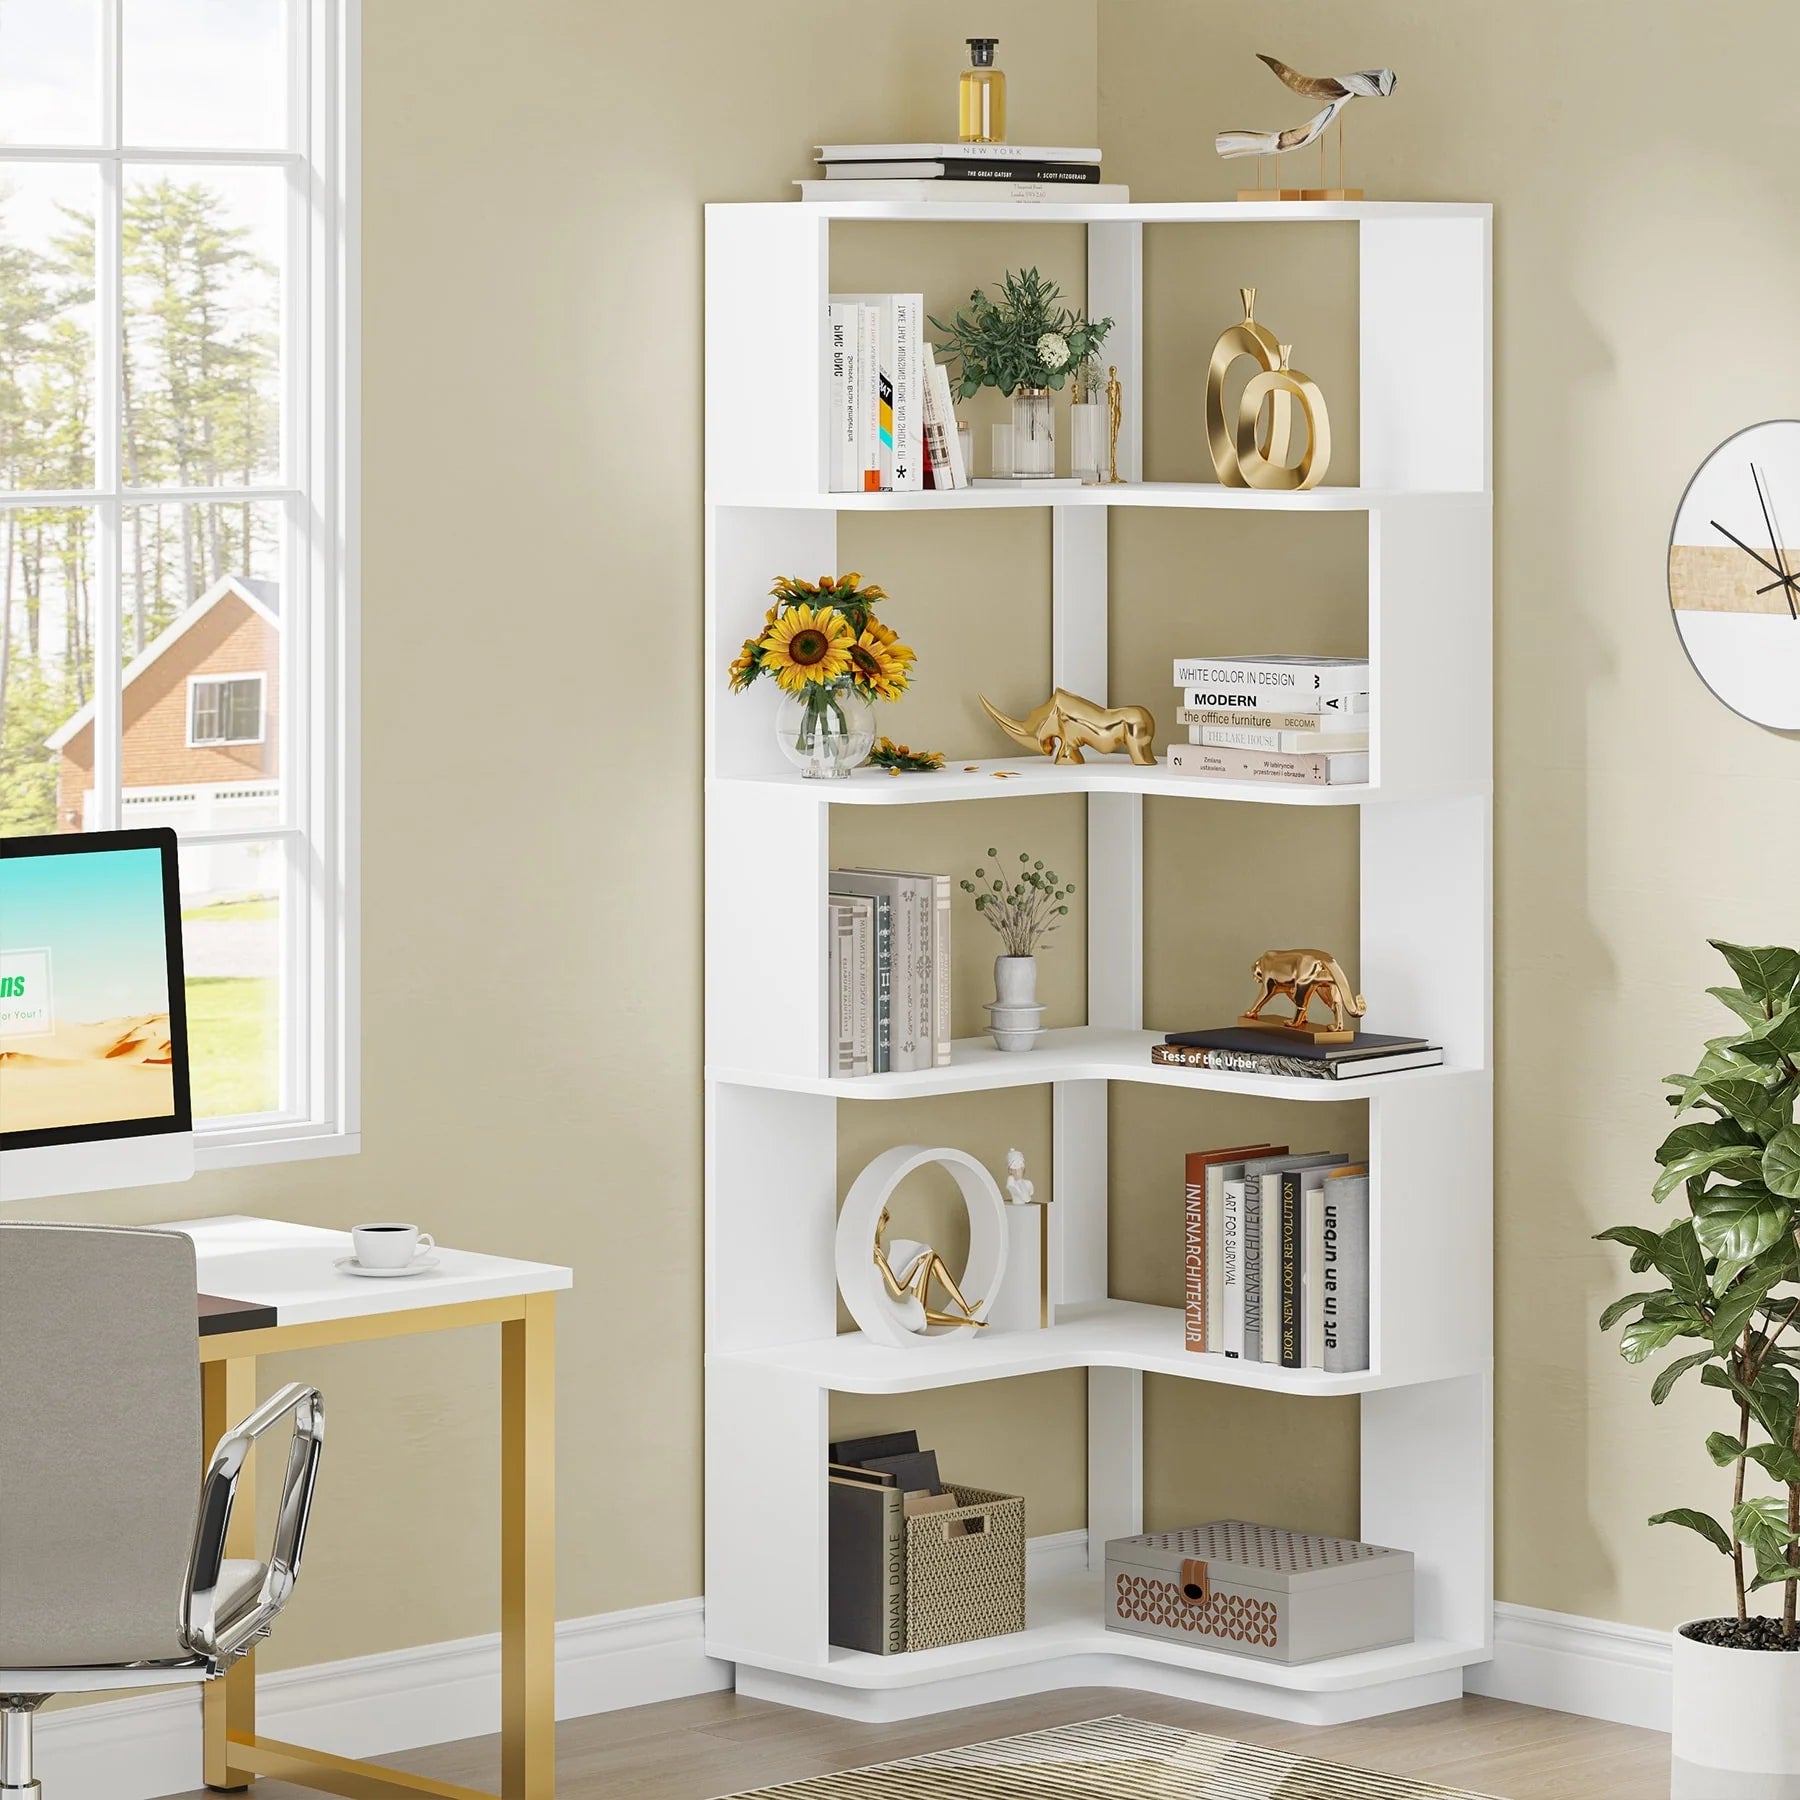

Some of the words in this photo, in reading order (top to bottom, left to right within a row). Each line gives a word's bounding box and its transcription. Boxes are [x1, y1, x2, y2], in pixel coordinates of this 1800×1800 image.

[963, 147, 987, 155] NEW
[993, 148, 1022, 156] YORK
[1179, 667, 1209, 682] WHITE
[1211, 669, 1244, 683] COLOR
[1246, 671, 1256, 684] IN
[1258, 672, 1295, 686] DESIGN
[1194, 693, 1257, 707] MODERN
[1326, 698, 1339, 709] A
[1184, 711, 1199, 722] the
[1231, 713, 1272, 727] furniture
[1284, 718, 1316, 728] DECOMA
[1206, 731, 1224, 741] THE
[1225, 732, 1245, 743] LAKE
[1247, 734, 1274, 747] HOUSE
[1173, 756, 1182, 766] 2
[0, 1012, 11, 1021] or
[14, 1010, 36, 1020] Your
[1161, 1050, 1186, 1063] Tess
[1188, 1052, 1201, 1064] of
[1202, 1054, 1222, 1065] the
[1225, 1056, 1258, 1069] Urber
[1225, 1192, 1236, 1213] ART
[1225, 1215, 1236, 1236] FOR
[1283, 1182, 1294, 1259] REVOLUTION
[1323, 1205, 1338, 1262] urban
[1185, 1183, 1202, 1342] INNENARCHITEKTUR
[1225, 1240, 1236, 1285] SURVIVAL
[1244, 1173, 1260, 1333] INNENARCHITEKTUR
[1283, 1261, 1294, 1294] LOOK
[1325, 1268, 1337, 1291] an
[1284, 1297, 1294, 1325] NEW
[1323, 1297, 1337, 1315] in
[1283, 1326, 1294, 1360] DIOR.
[1323, 1321, 1337, 1348] art
[889, 1503, 900, 1513] II
[889, 1534, 900, 1585] DOYLE
[889, 1594, 900, 1652] CONAN
